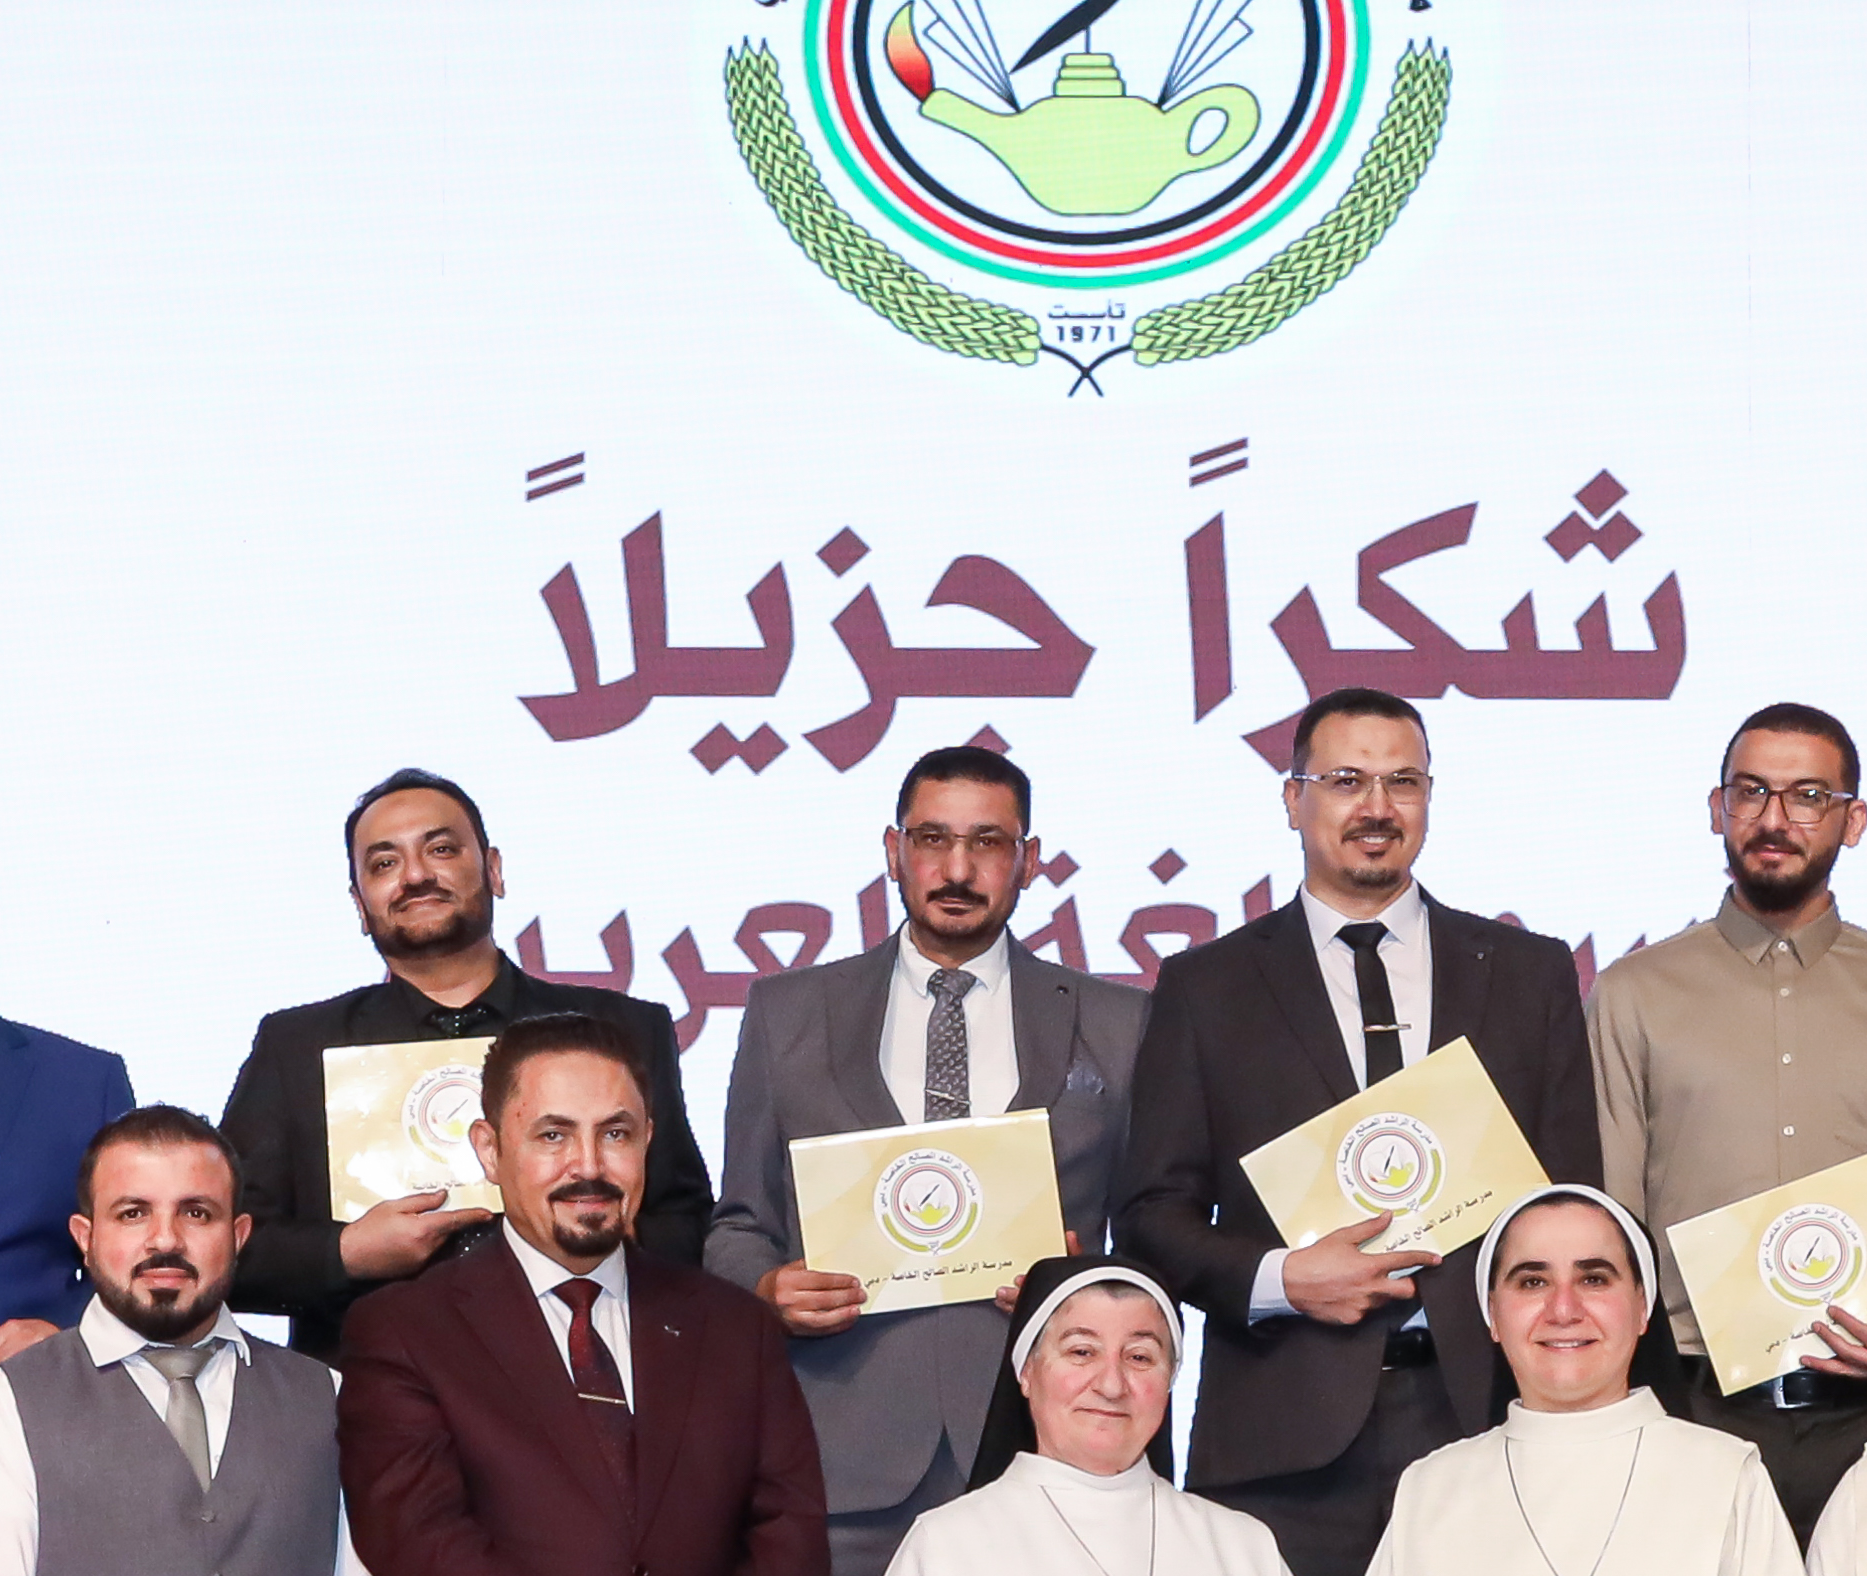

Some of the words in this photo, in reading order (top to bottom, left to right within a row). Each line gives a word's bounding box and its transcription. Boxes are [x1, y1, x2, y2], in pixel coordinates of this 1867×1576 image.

[1048, 300, 1126, 320] تأسست
[1056, 326, 1116, 342] 1971
[518, 451, 1098, 776] جزيلاً
[1187, 438, 1688, 774] شكراً
